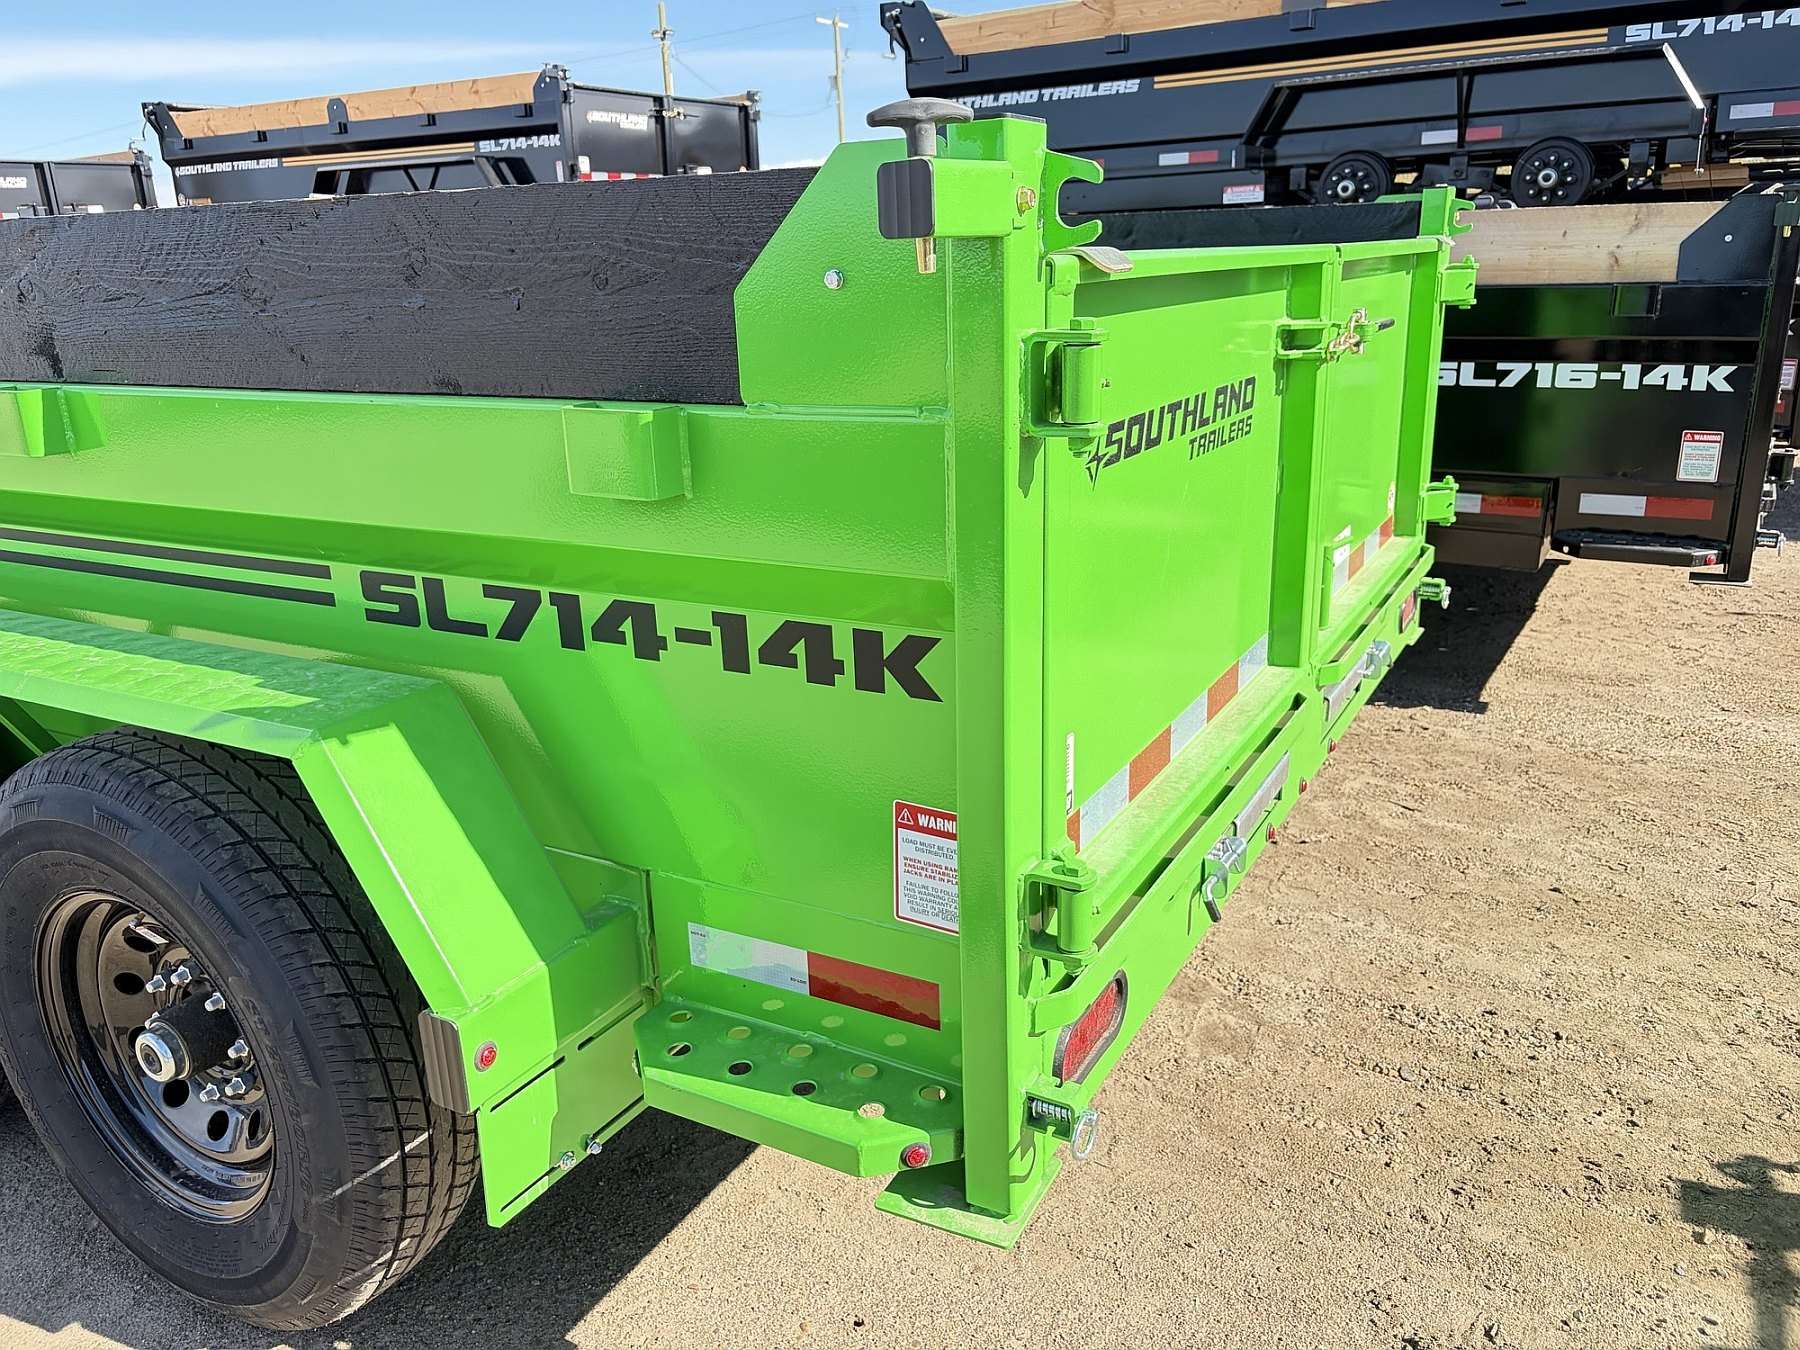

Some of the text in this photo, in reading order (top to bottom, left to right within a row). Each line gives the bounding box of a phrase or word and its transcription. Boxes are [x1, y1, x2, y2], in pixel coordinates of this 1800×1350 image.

[1041, 79, 1141, 101] TRAILERS
[479, 134, 561, 152] SL714-14K
[179, 158, 279, 176] SOUTHLAND TRAILERS
[1102, 376, 1257, 470] SOUTHLAND
[1189, 414, 1253, 461] TRAILERS
[359, 569, 944, 704] SL714-14K
[902, 837, 918, 846] LOAD
[919, 841, 936, 850] MUST
[914, 846, 954, 860] DISTRIBUTED
[903, 856, 922, 865] WHEN
[923, 860, 943, 870] USING
[904, 862, 930, 872] ENSURE
[904, 868, 923, 877] JACKS
[924, 873, 937, 881] ARE
[904, 885, 917, 894] THIS
[918, 889, 946, 901] WARNING
[905, 880, 930, 892] FAILURE
[931, 886, 939, 894] TO
[919, 895, 952, 909] WARRANTY
